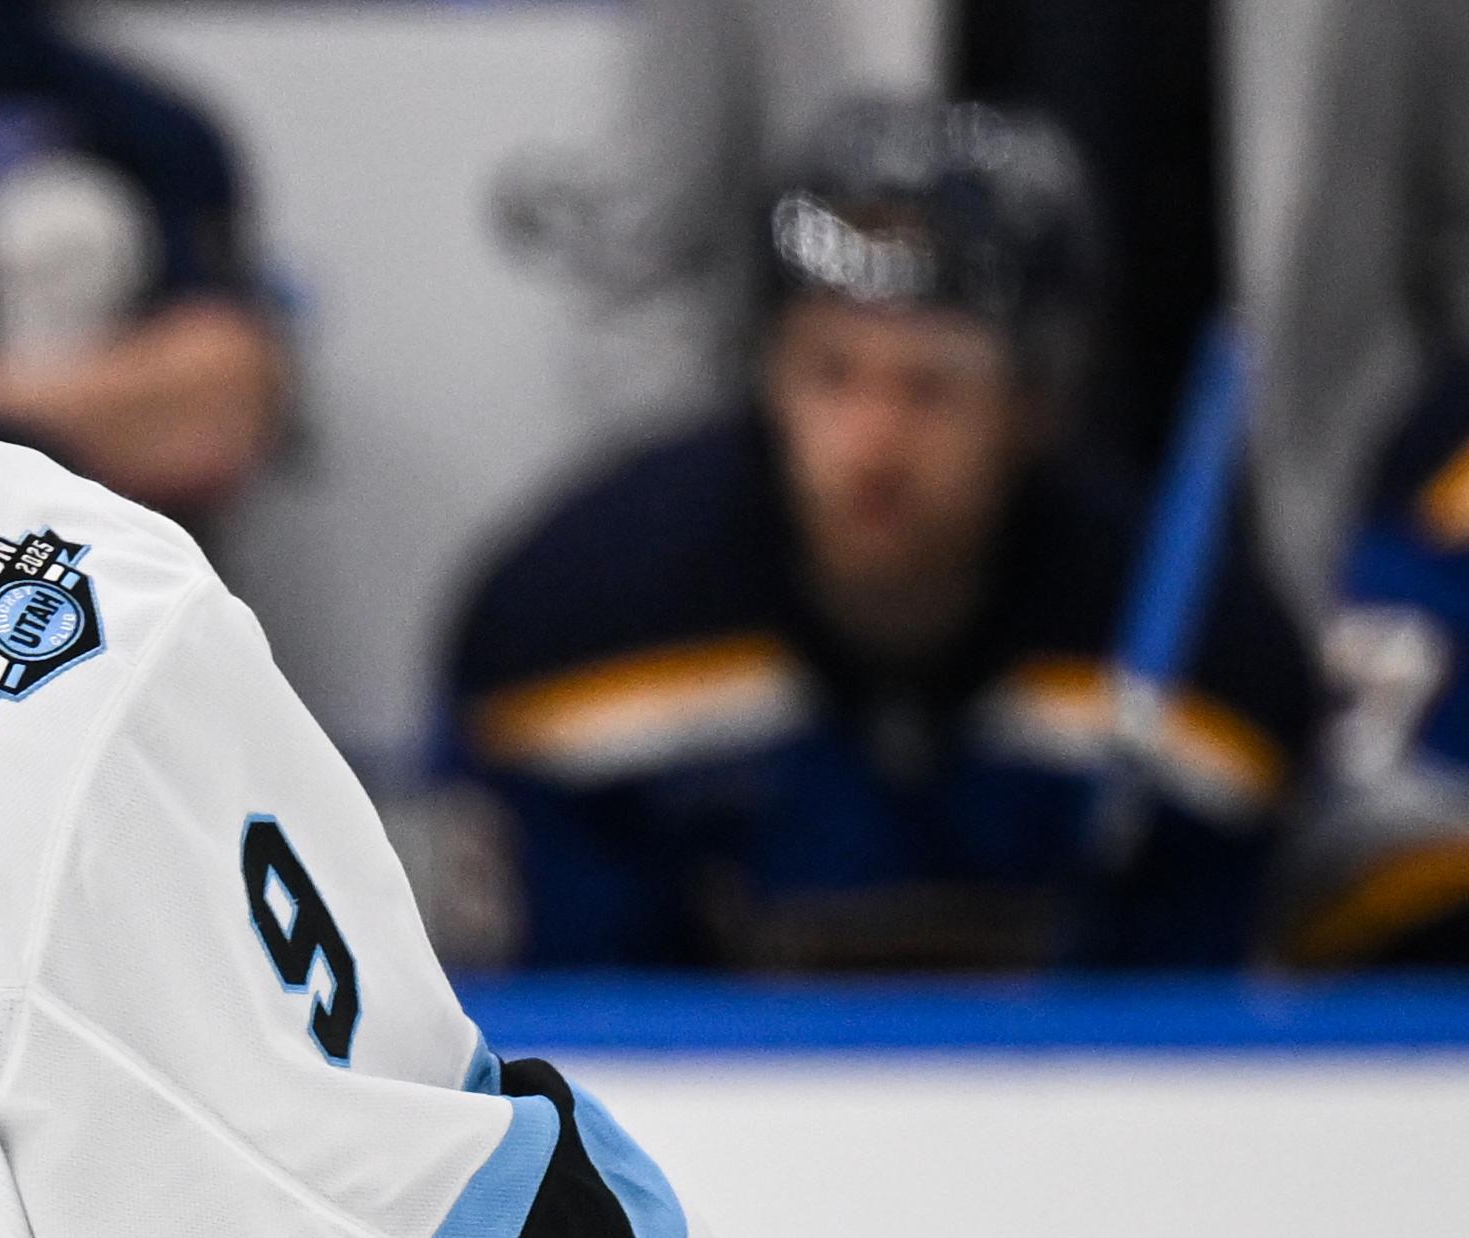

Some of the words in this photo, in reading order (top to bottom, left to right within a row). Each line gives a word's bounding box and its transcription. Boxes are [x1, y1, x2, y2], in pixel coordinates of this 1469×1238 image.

[15, 539, 55, 575] 2025
[8, 590, 65, 649] UTAH
[239, 812, 363, 1068] 9
